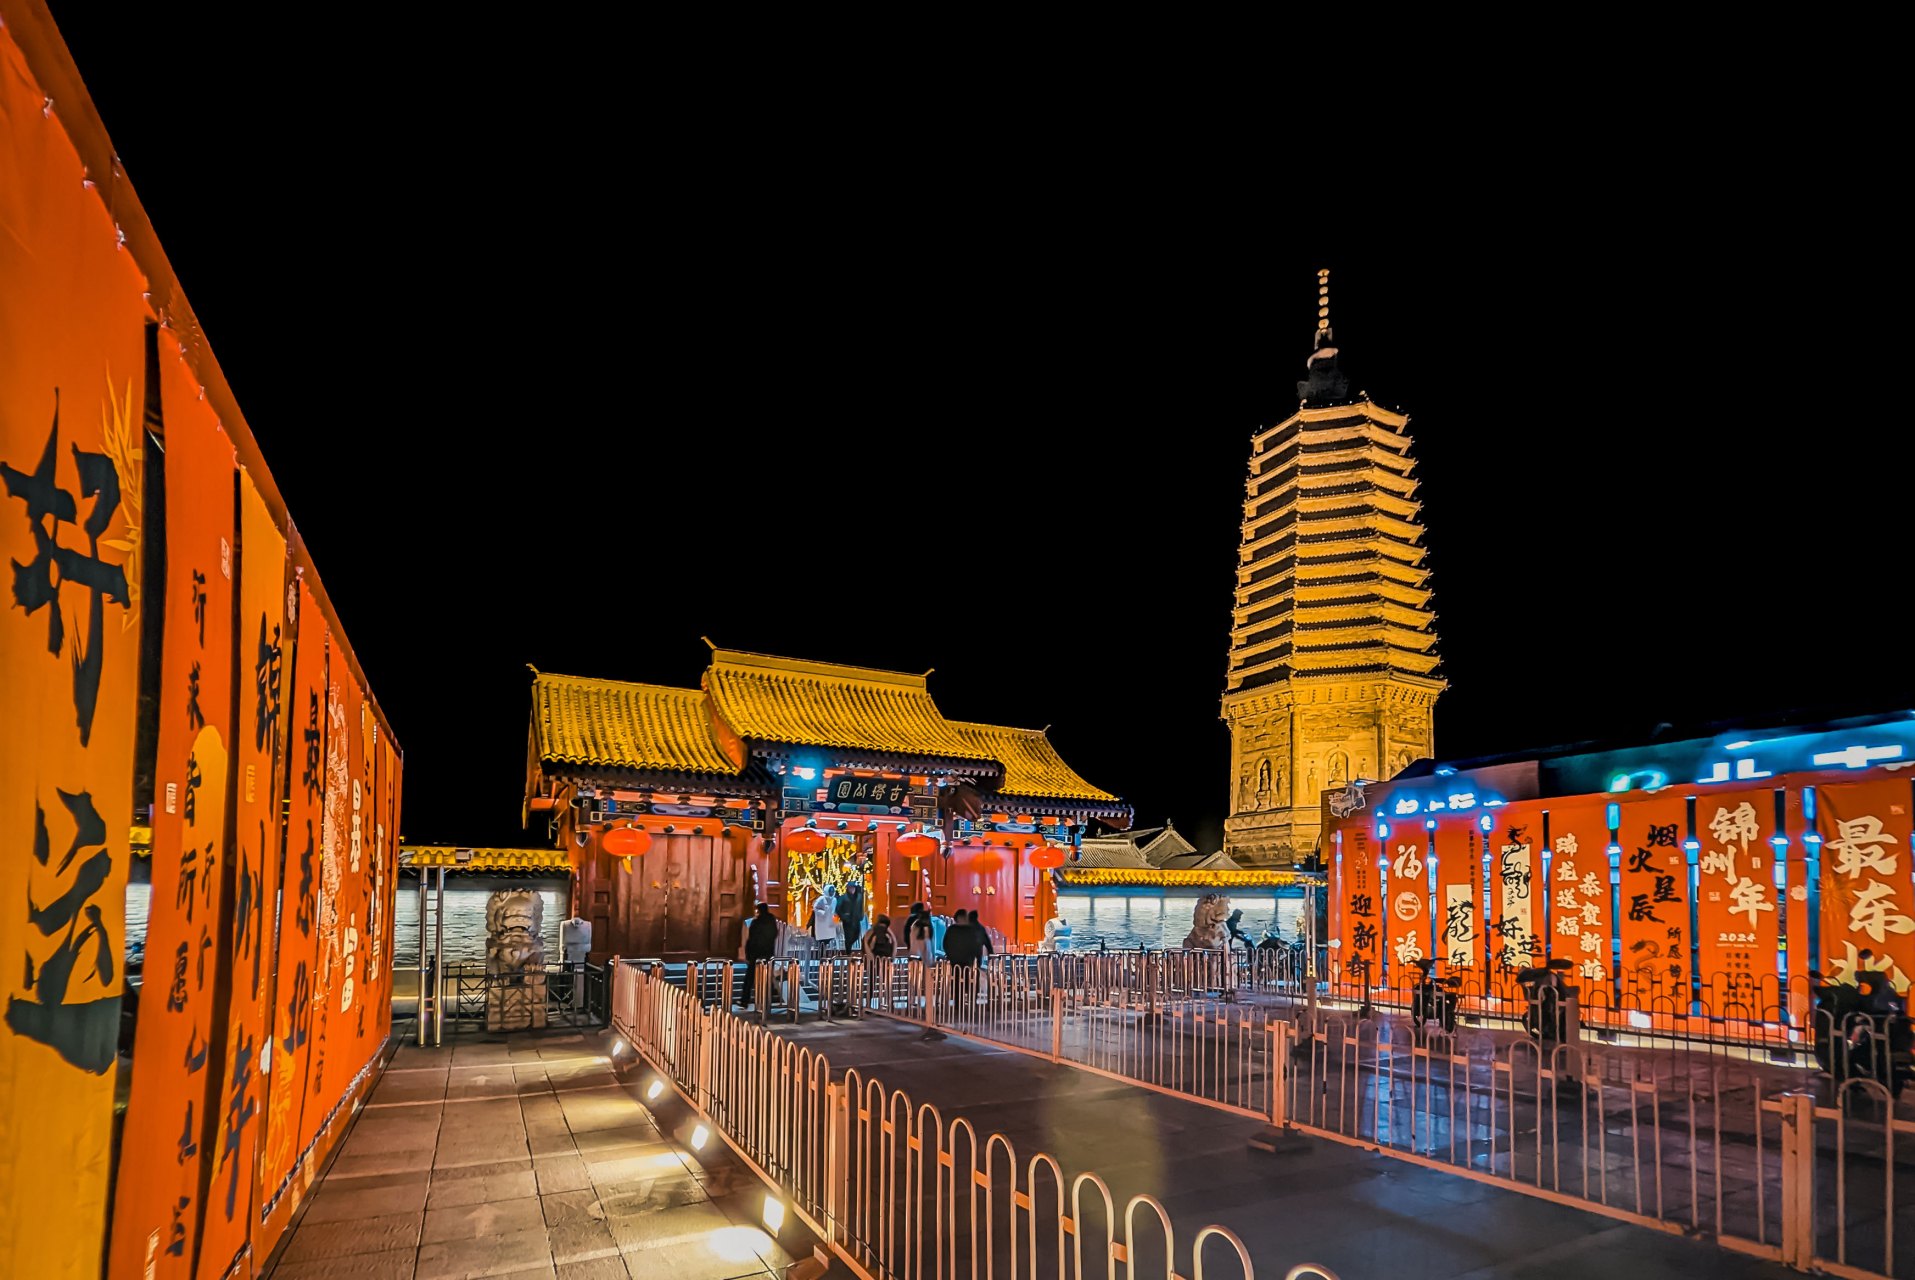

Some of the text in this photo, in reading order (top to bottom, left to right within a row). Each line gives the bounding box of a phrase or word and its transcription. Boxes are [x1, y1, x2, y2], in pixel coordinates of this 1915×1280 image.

[1492, 914, 1545, 984] 好运常
[1718, 932, 1757, 943] 2024
